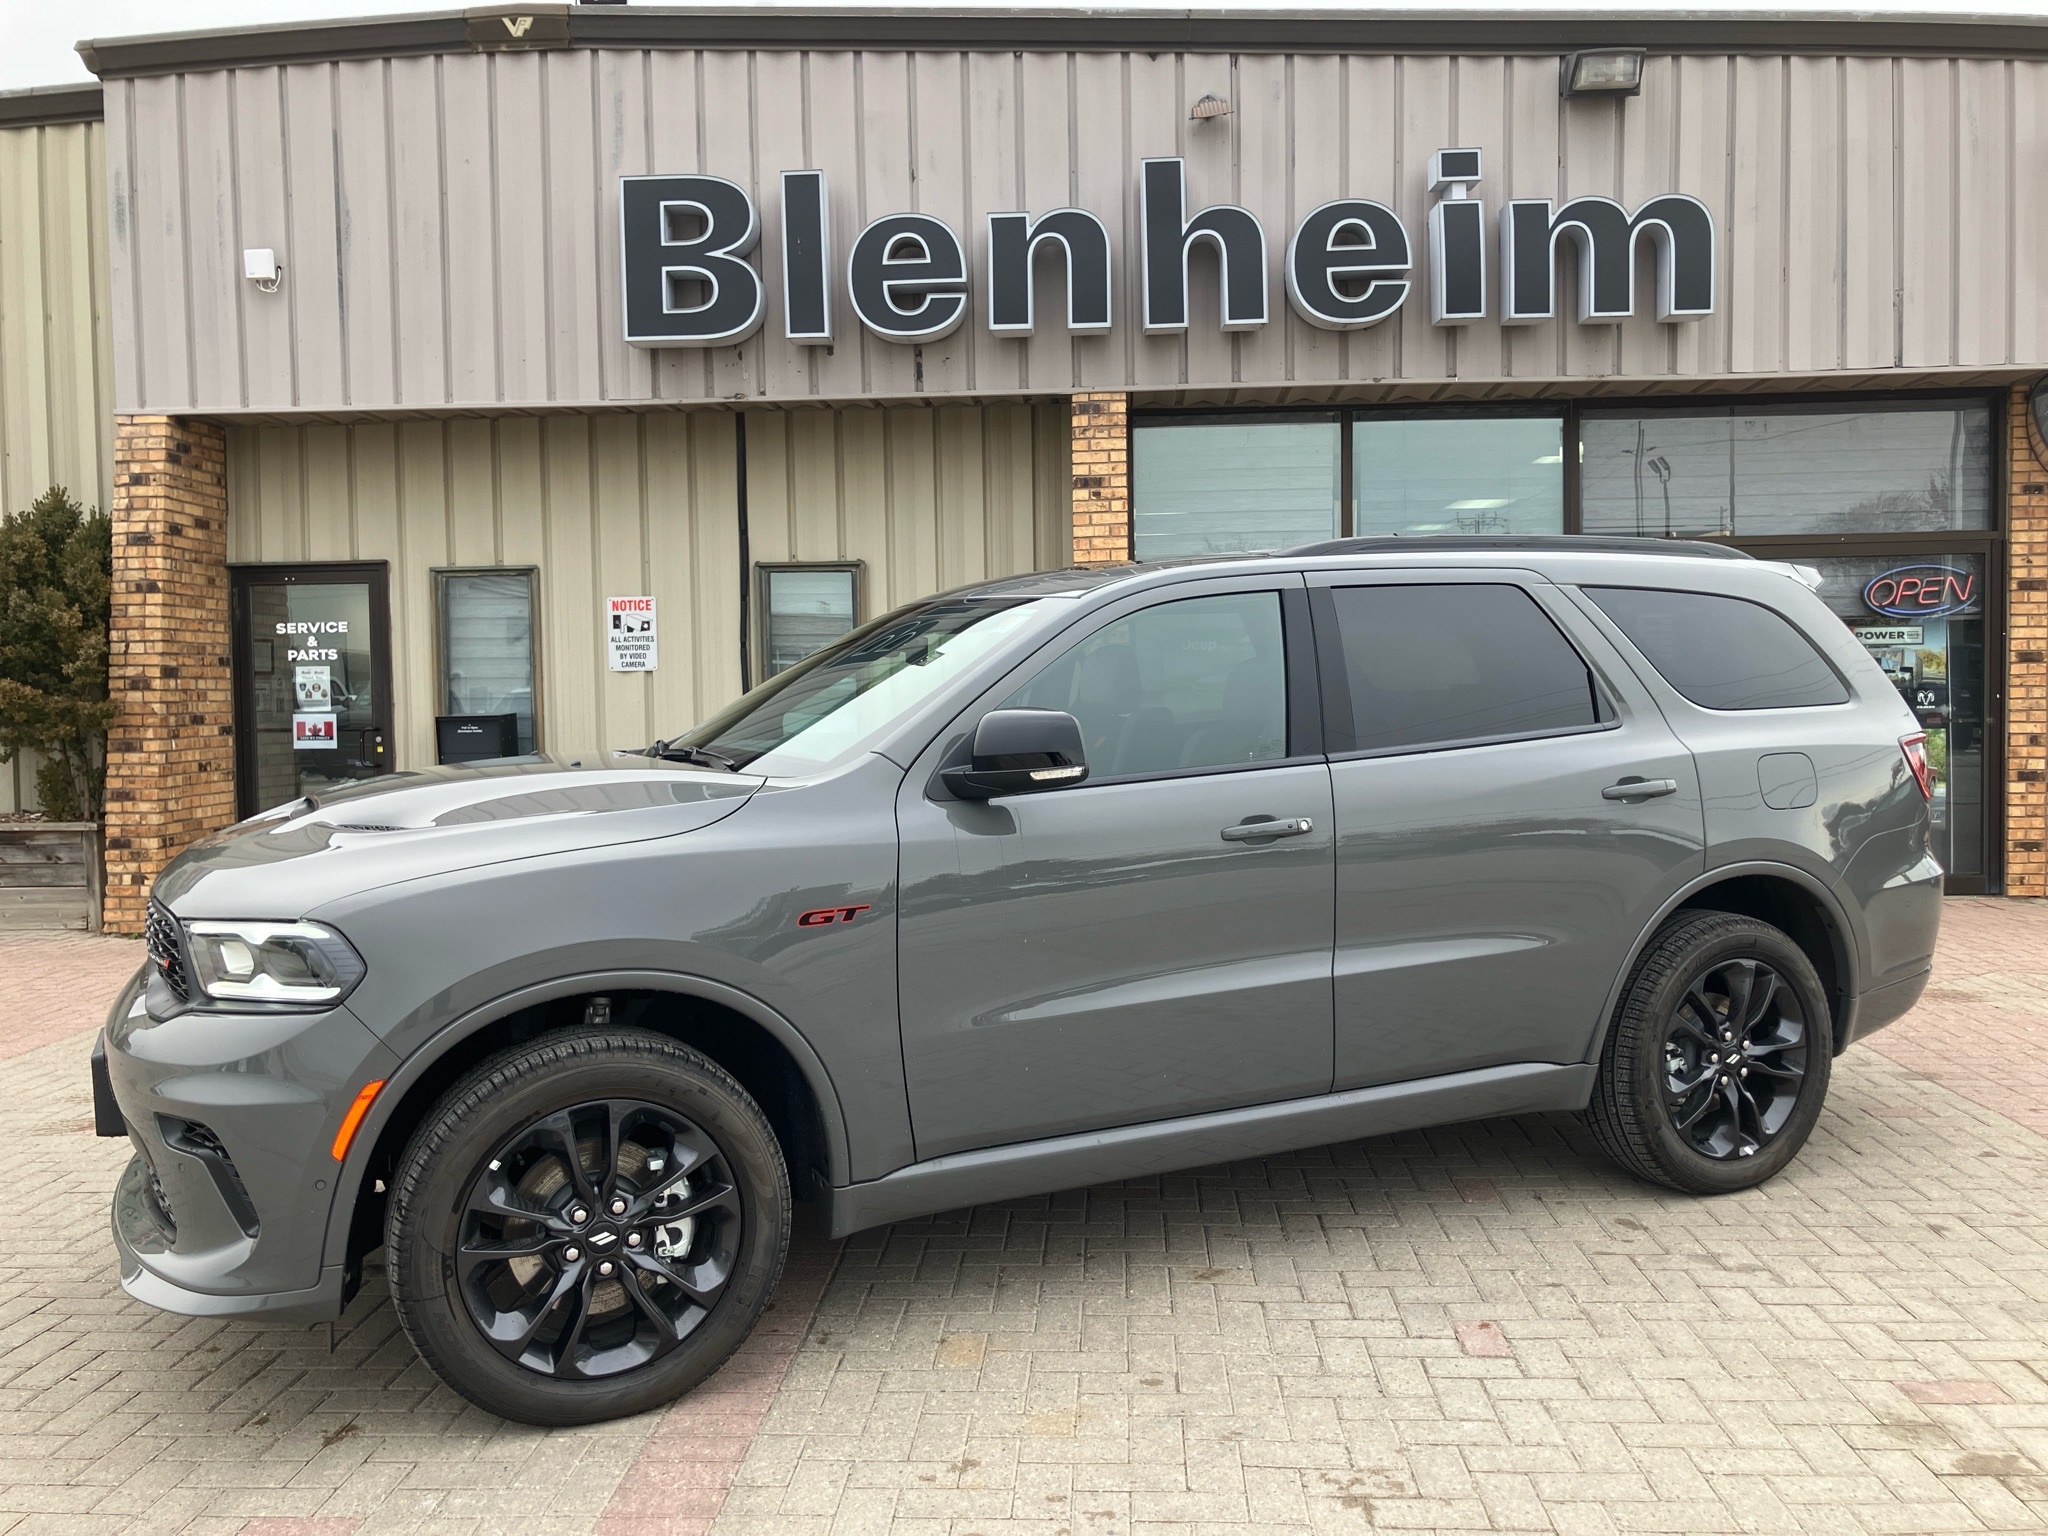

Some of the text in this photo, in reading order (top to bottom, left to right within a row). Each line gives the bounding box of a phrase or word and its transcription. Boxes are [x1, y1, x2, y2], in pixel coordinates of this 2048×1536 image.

[618, 147, 1718, 348] Blenheim
[1870, 575, 1974, 606] OPEN
[612, 600, 652, 611] NOTICE
[275, 621, 348, 635] SERVICE
[306, 635, 318, 647] &
[623, 635, 655, 643] ACTIVITIES
[1854, 631, 1906, 640] POWER
[615, 644, 651, 652] MONITORED
[1182, 638, 1218, 652] Jeep
[287, 648, 338, 662] PARTS
[629, 652, 647, 660] VIDEO
[798, 903, 871, 928] GT
